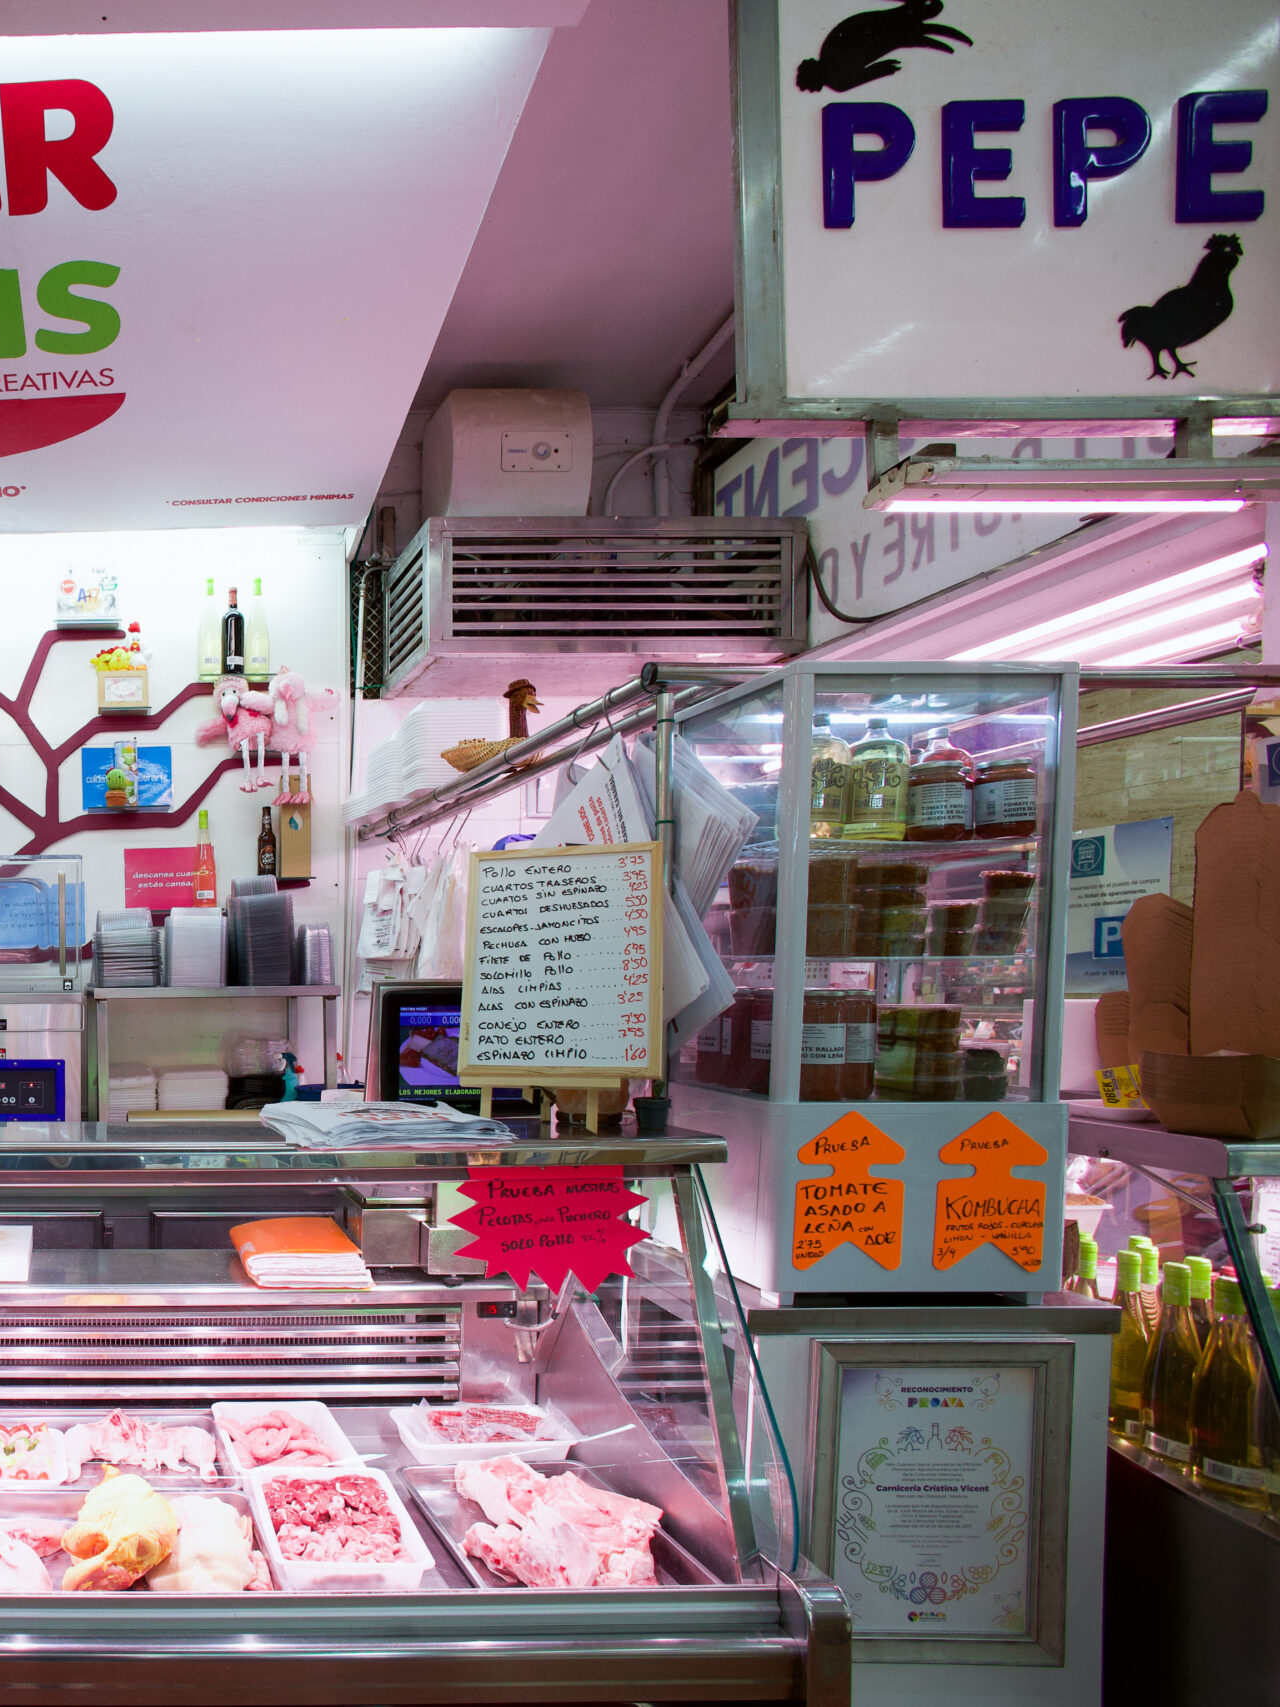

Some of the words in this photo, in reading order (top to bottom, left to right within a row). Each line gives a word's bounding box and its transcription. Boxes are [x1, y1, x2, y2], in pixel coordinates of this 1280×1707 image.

[821, 89, 1269, 229] PEPE
[172, 498, 232, 506] CONSULTAR
[234, 495, 307, 503] CONDICIONES
[524, 865, 572, 875] ENTERO
[482, 882, 534, 894] CUARTOS
[536, 876, 597, 888] TRASEROS
[481, 894, 528, 906] CUARTOS
[561, 885, 607, 896] ESPINAZO
[482, 908, 528, 919] CUARTOS
[483, 940, 528, 950] PECHUGA
[539, 937, 559, 946] CON
[1101, 921, 1122, 953] P
[519, 954, 531, 963] DE
[515, 1000, 535, 1010] CON
[539, 996, 588, 1009] ESPINAZO
[536, 1019, 580, 1030] ENTERO
[478, 1035, 509, 1046] PATO
[515, 1034, 564, 1046] ENTERO
[476, 1049, 536, 1061] ESPINAZO
[814, 1136, 871, 1156] PRUEBA
[959, 1138, 1010, 1152] PRUEBA
[488, 1179, 554, 1200] PRUEBA
[565, 1182, 621, 1195] NUESTRAS
[800, 1182, 888, 1200] TOMATE
[804, 1202, 866, 1217] ASADO
[873, 1201, 886, 1213] A
[945, 1194, 1041, 1220] KOMBUCHA
[477, 1207, 533, 1227] PELOTAS
[557, 1207, 611, 1224] PUCHERO
[804, 1219, 854, 1234] LEÑA
[946, 1223, 974, 1231] FRUTOS
[501, 1235, 534, 1253] SOLO
[944, 1235, 973, 1243] LIMON
[937, 1246, 956, 1262] 3/4
